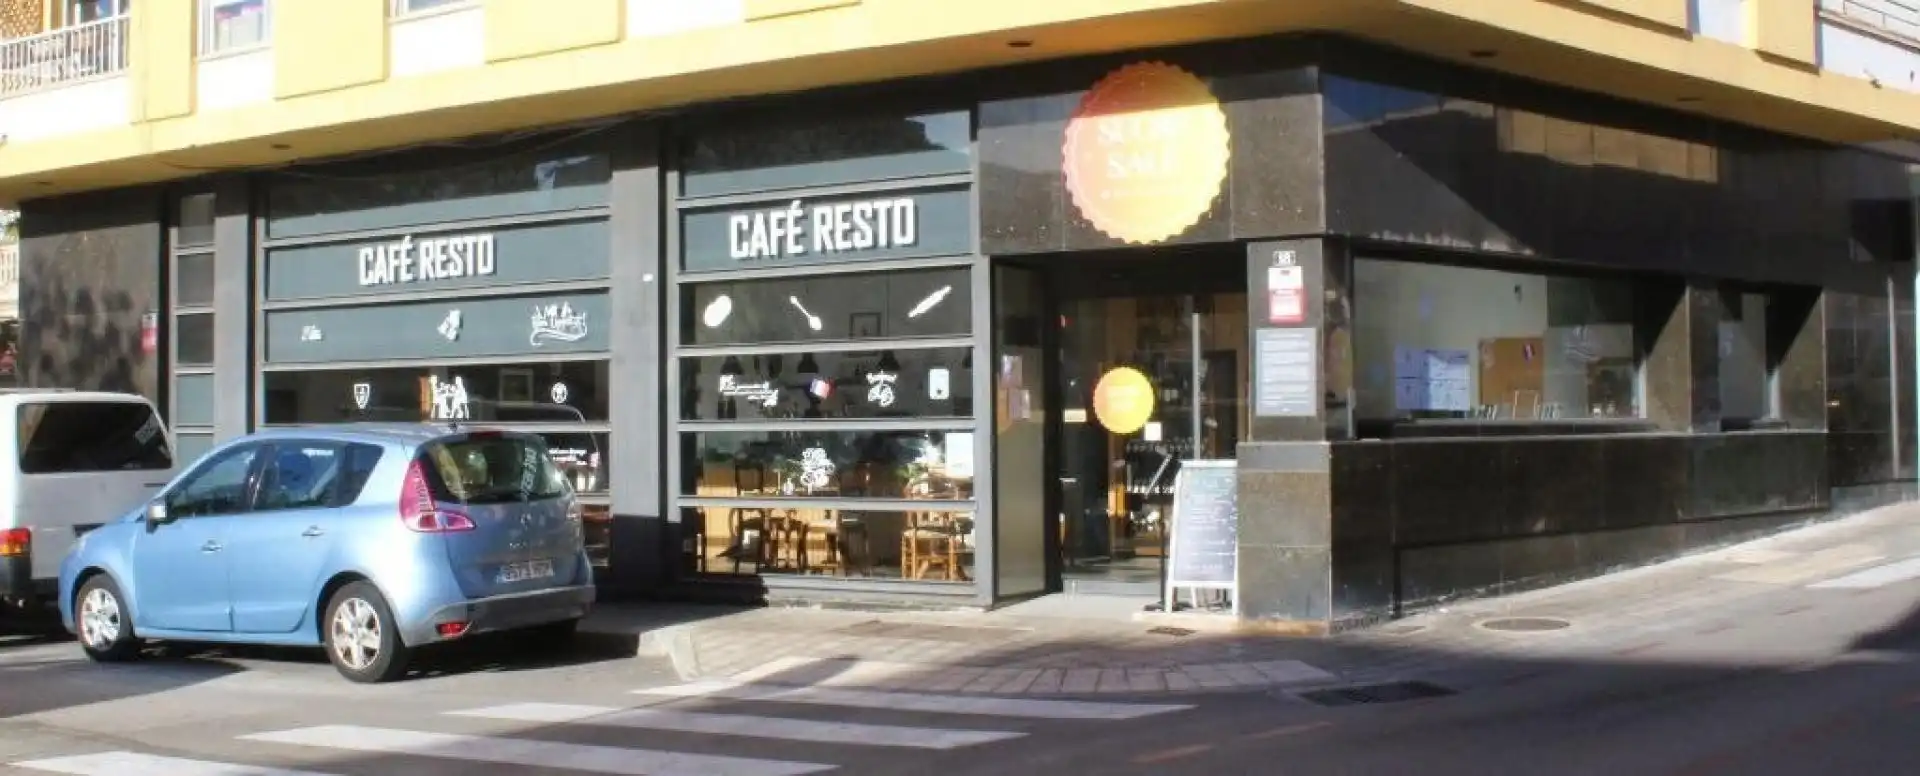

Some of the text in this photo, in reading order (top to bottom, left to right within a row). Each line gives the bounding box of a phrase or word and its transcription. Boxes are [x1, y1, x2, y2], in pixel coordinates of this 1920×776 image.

[731, 198, 915, 259] CAFÉ RESTO
[359, 233, 494, 286] CAFÉ RESTO
